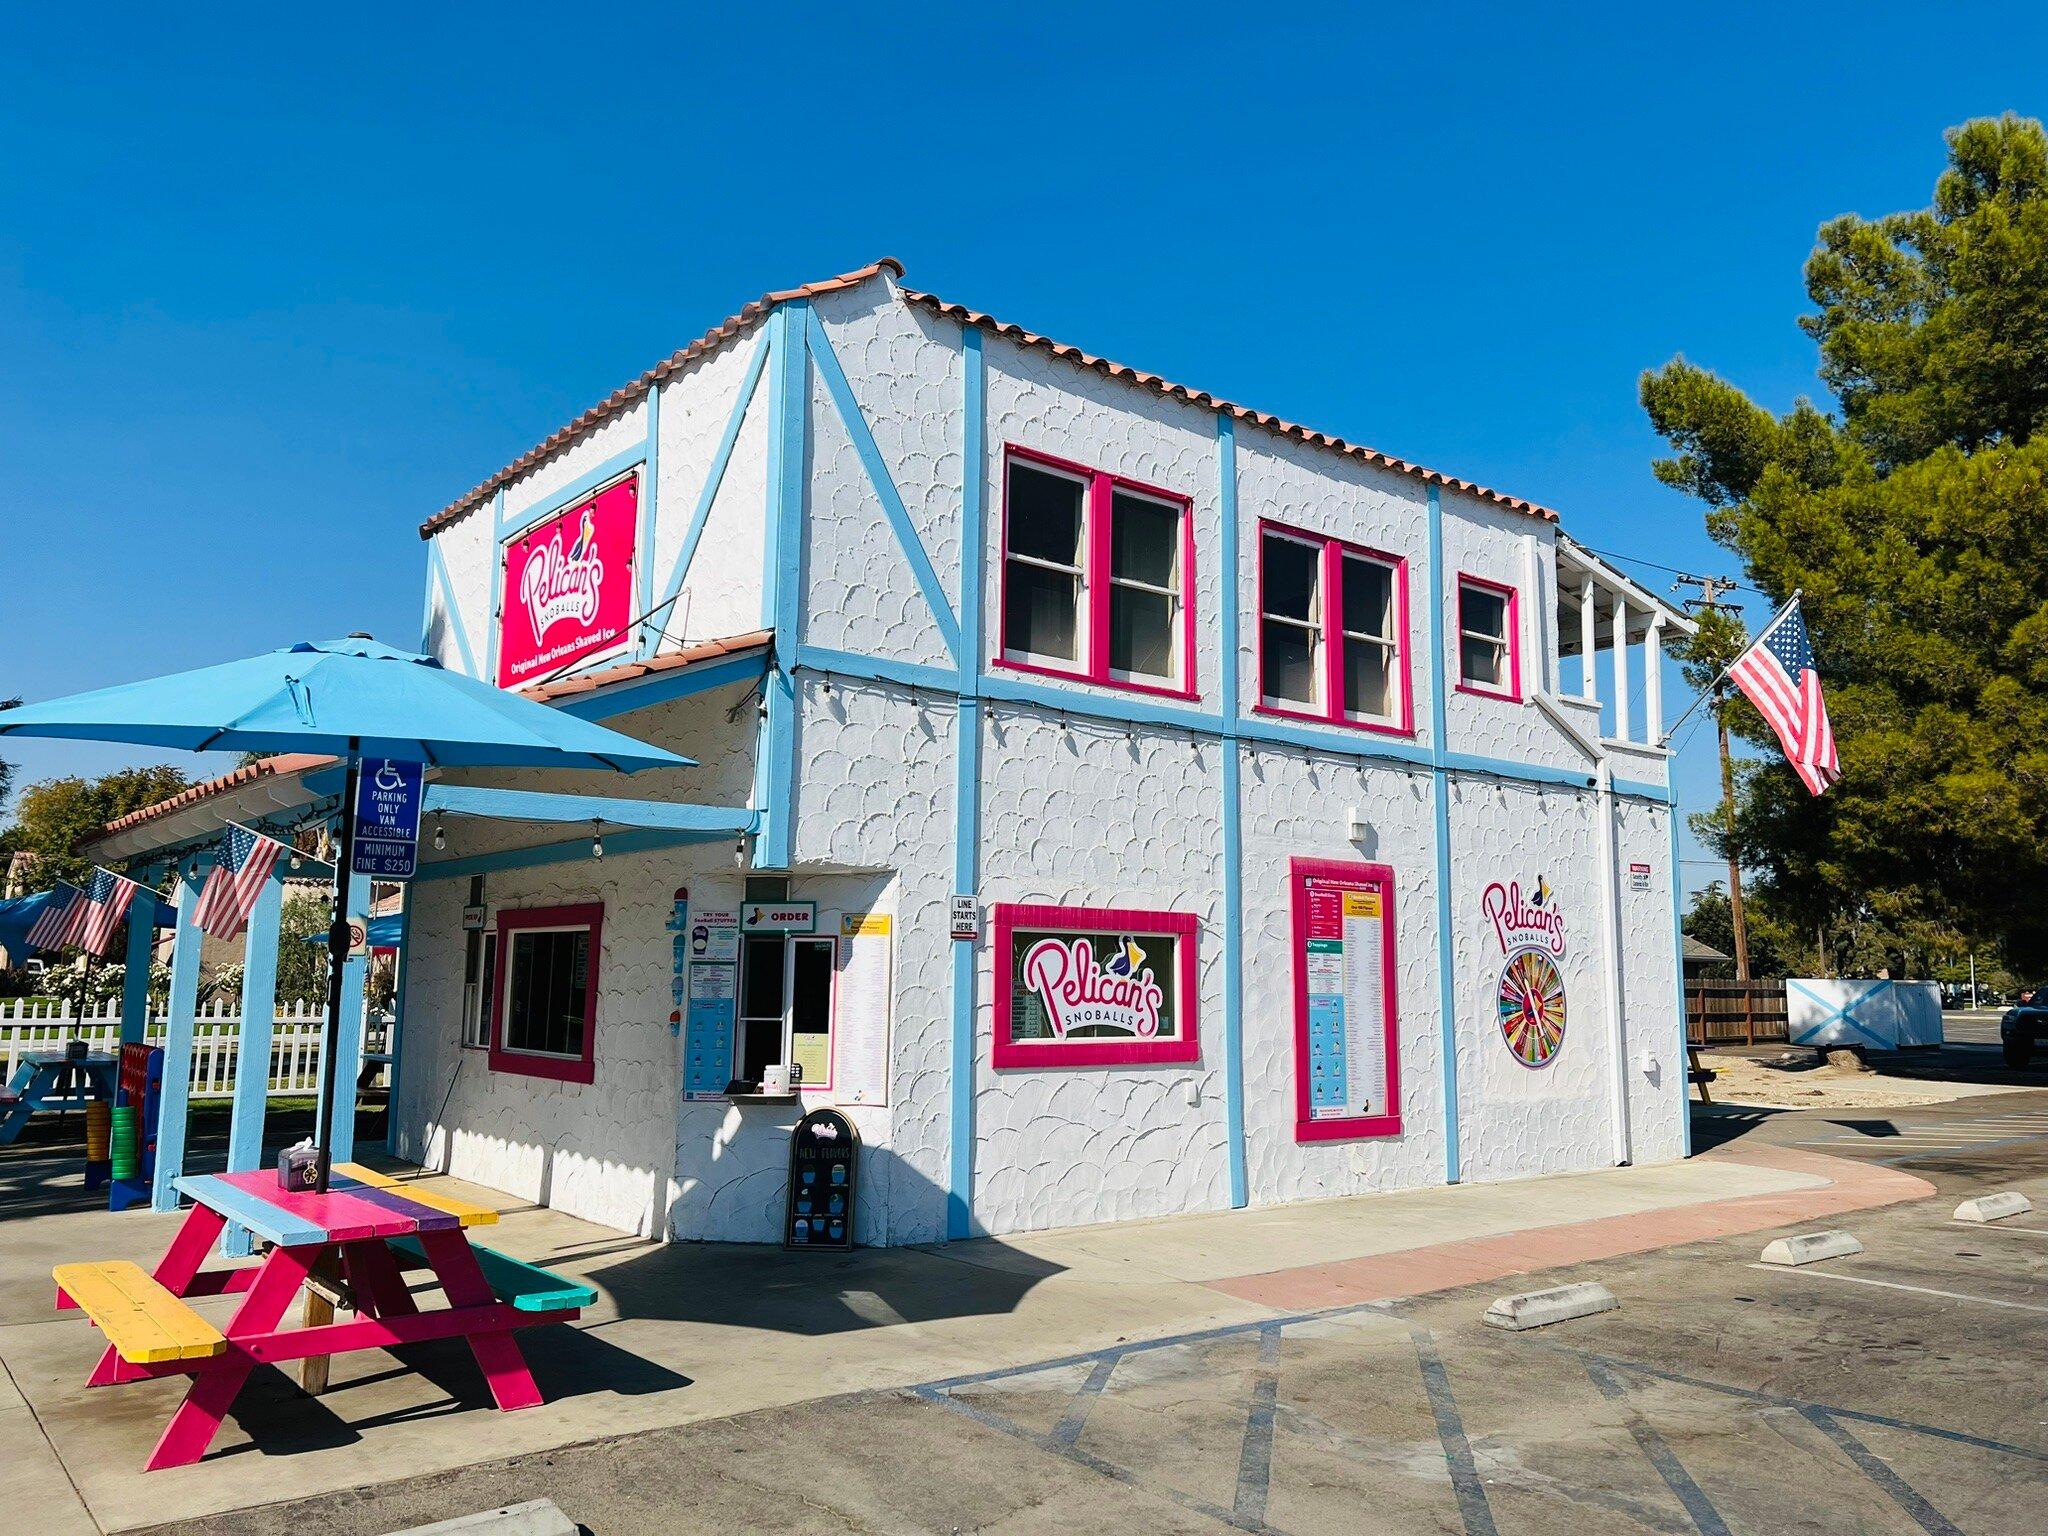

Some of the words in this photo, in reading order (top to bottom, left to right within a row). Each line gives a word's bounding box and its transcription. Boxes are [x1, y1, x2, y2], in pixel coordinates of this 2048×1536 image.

[520, 535, 604, 647] Pelican's
[540, 601, 580, 629] SNOBALLS
[511, 655, 538, 674] Original
[537, 651, 552, 665] New
[551, 641, 576, 659] Orleans
[575, 628, 602, 650] Shaved
[602, 627, 616, 641] Ice
[371, 790, 407, 803] PARKING
[377, 803, 400, 814] ONLY
[379, 814, 395, 825] VAN
[361, 825, 411, 839] ACCESSIBLE
[364, 843, 405, 857] MINIMUM
[356, 857, 377, 870] FINE
[384, 858, 411, 872] $250
[957, 899, 972, 908] LINE
[771, 912, 809, 921] ORDER
[952, 911, 976, 920] STARTS
[1483, 882, 1564, 954] Pelican's
[956, 922, 973, 931] HERE
[1507, 934, 1549, 946] SNOBALLS
[1026, 940, 1161, 1037] Pelican's
[1065, 1010, 1134, 1026] SNOBALLS
